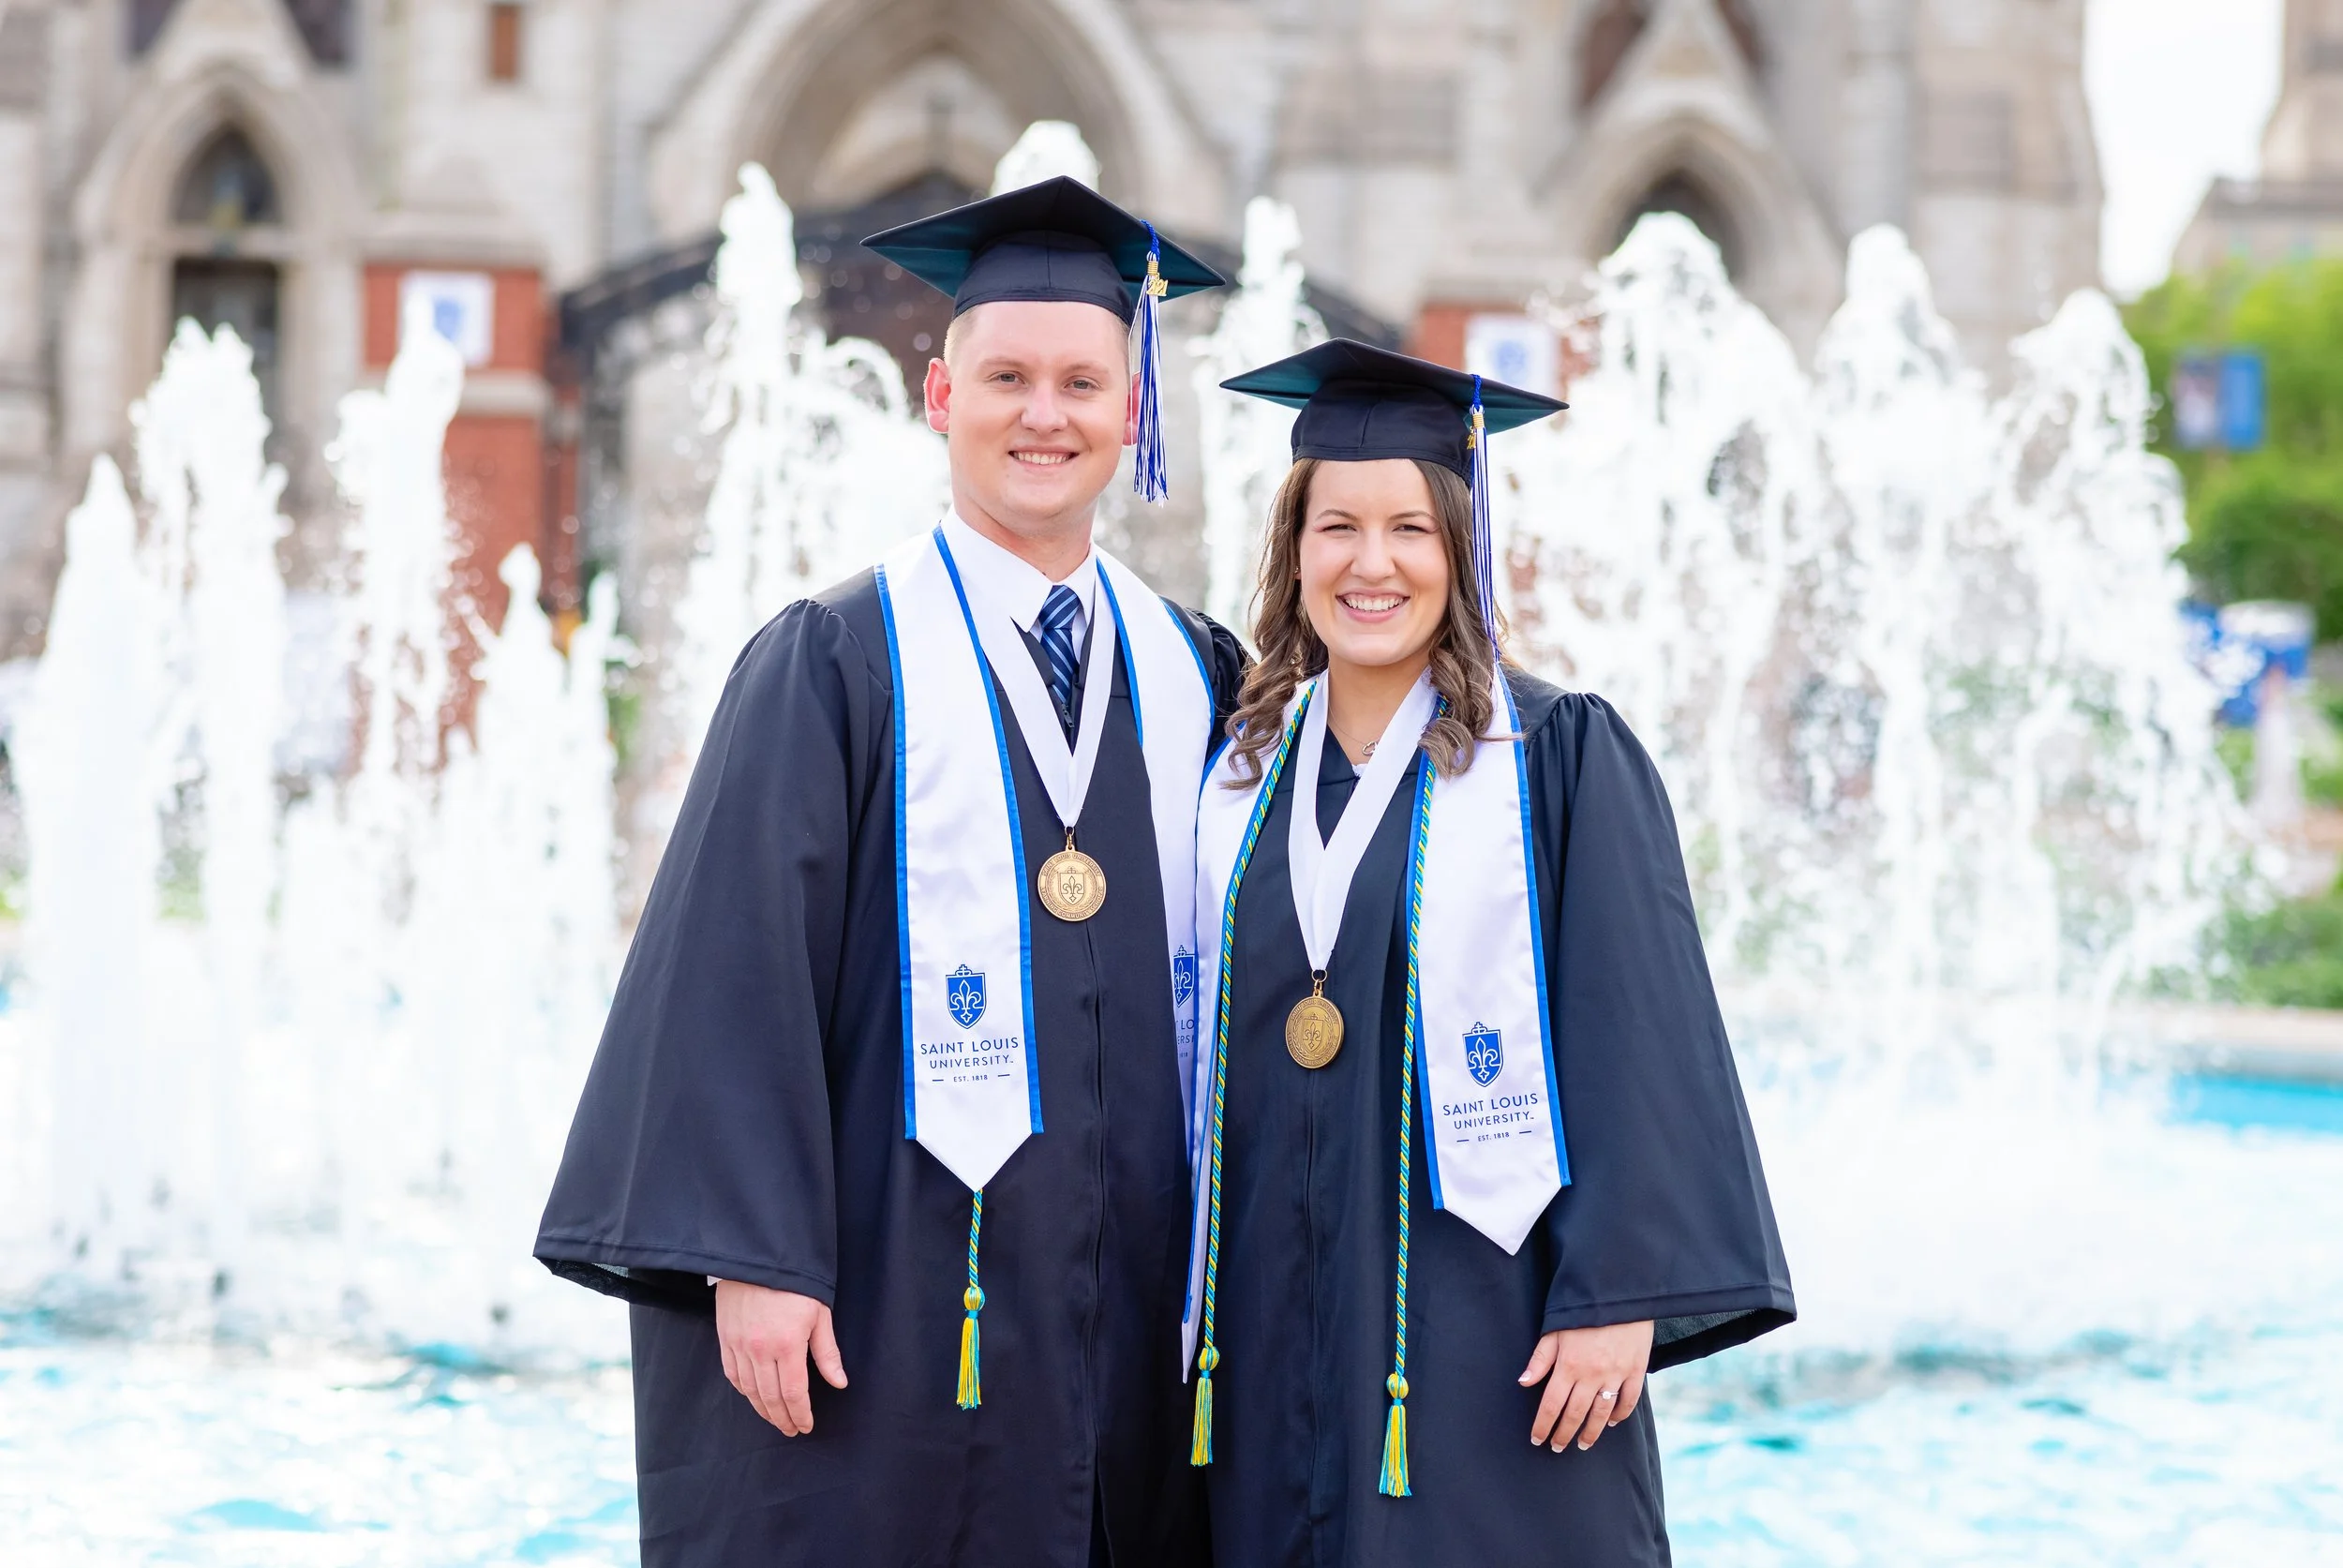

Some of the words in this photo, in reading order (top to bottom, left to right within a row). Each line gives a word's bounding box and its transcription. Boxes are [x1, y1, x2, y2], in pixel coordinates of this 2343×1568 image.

[920, 1041, 964, 1055] SAINT
[972, 1037, 1019, 1053] LOUIS
[1442, 1100, 1485, 1116] SAINT
[1491, 1093, 1539, 1110] LOUIS
[1478, 1134, 1492, 1142] EST.
[1494, 1131, 1510, 1140] 1818
